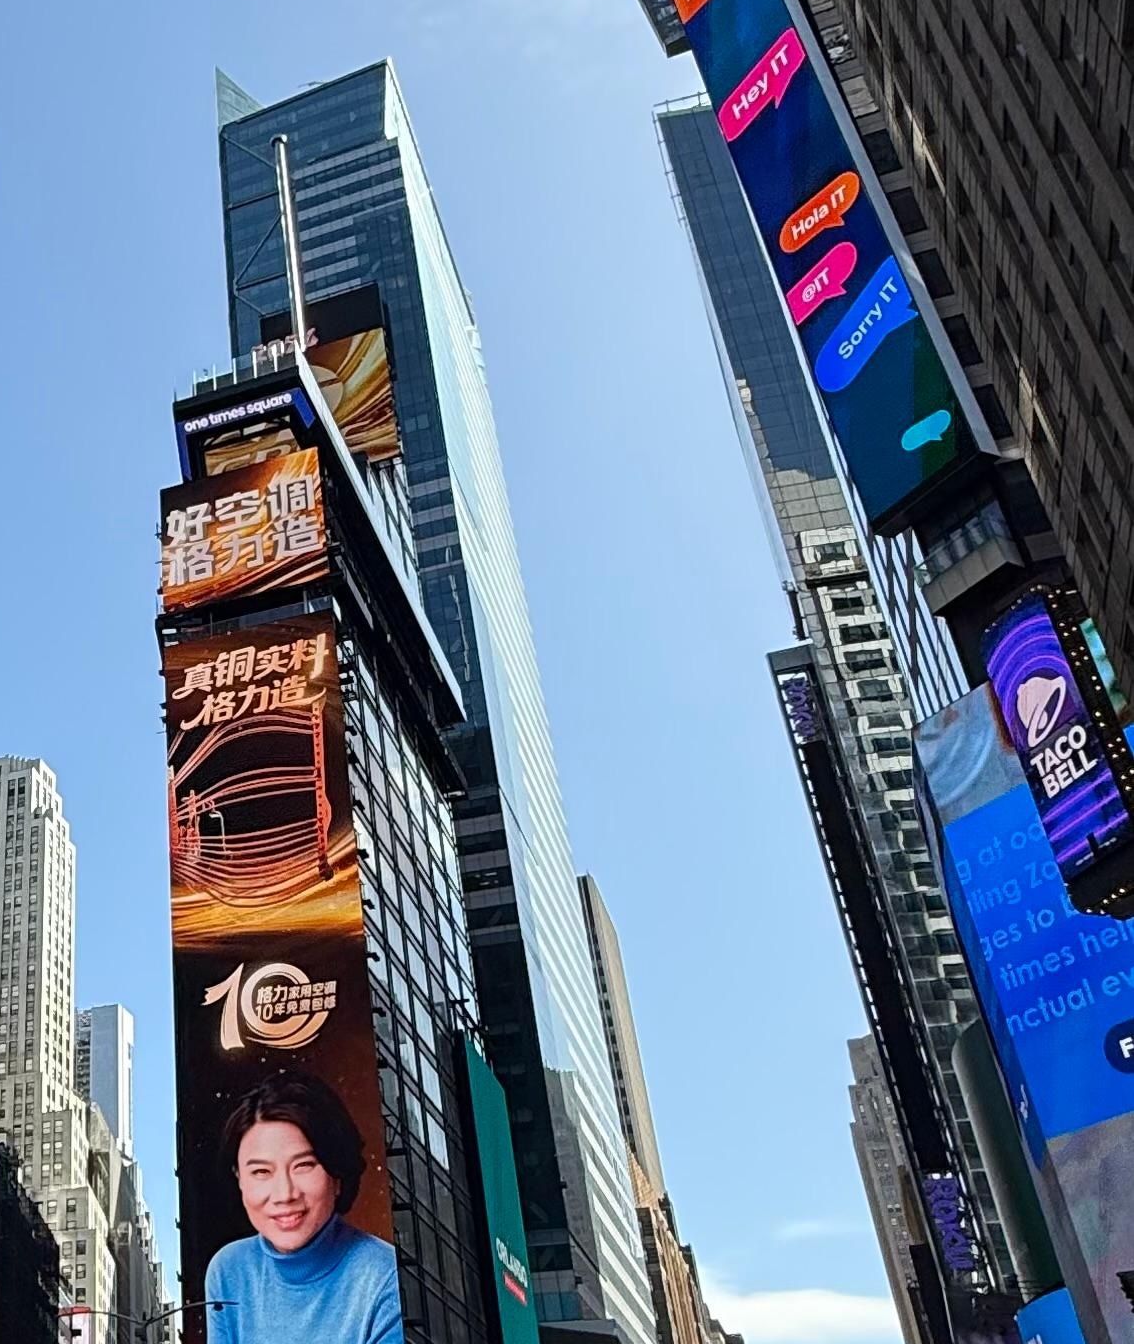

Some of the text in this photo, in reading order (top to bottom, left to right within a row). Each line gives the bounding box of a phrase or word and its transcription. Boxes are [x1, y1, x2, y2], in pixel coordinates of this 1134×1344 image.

[732, 44, 791, 120] Hey IT
[791, 184, 848, 241] Hola IT
[801, 267, 831, 303] @IT
[838, 276, 900, 361] Sorry IT
[184, 392, 293, 433] one times square
[166, 474, 316, 546] 好空调
[167, 515, 326, 586] 格力造
[172, 633, 330, 700] 真铜实料
[180, 674, 327, 731] 格力造
[1030, 725, 1088, 779] TACO
[1042, 749, 1099, 799] BELL
[978, 836, 1002, 866] at
[1026, 905, 1056, 934] to
